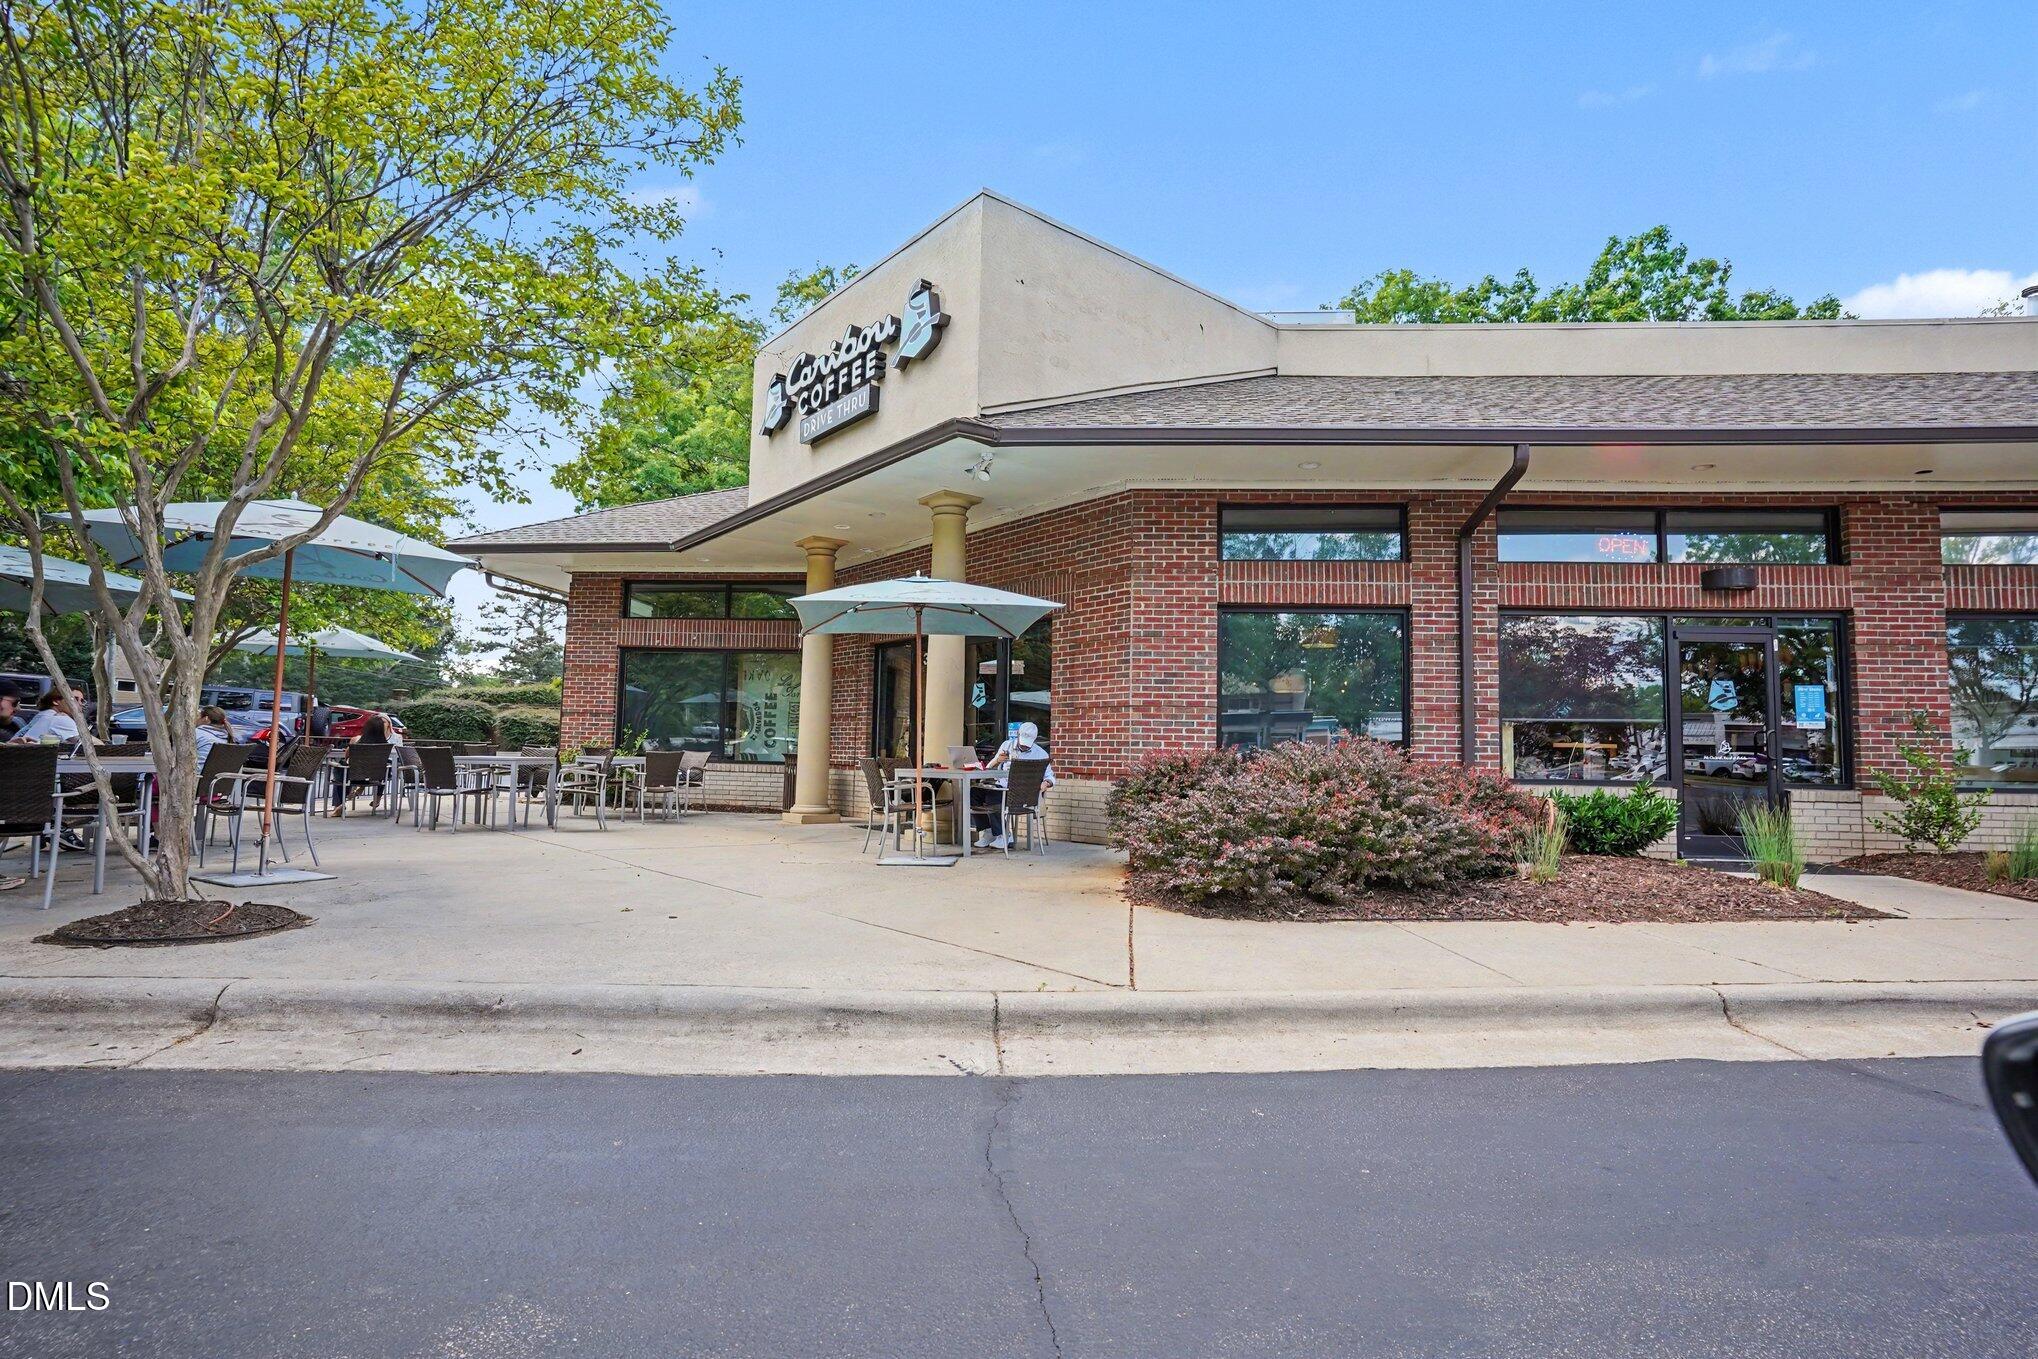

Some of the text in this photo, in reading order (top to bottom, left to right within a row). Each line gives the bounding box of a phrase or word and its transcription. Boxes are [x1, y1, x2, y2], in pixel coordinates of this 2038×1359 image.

[785, 314, 897, 396] Caribou
[798, 350, 877, 416] COFFEE
[803, 391, 867, 437] DRIVE THRU
[1598, 537, 1647, 554] OPEN
[763, 692, 778, 749] COFFEE
